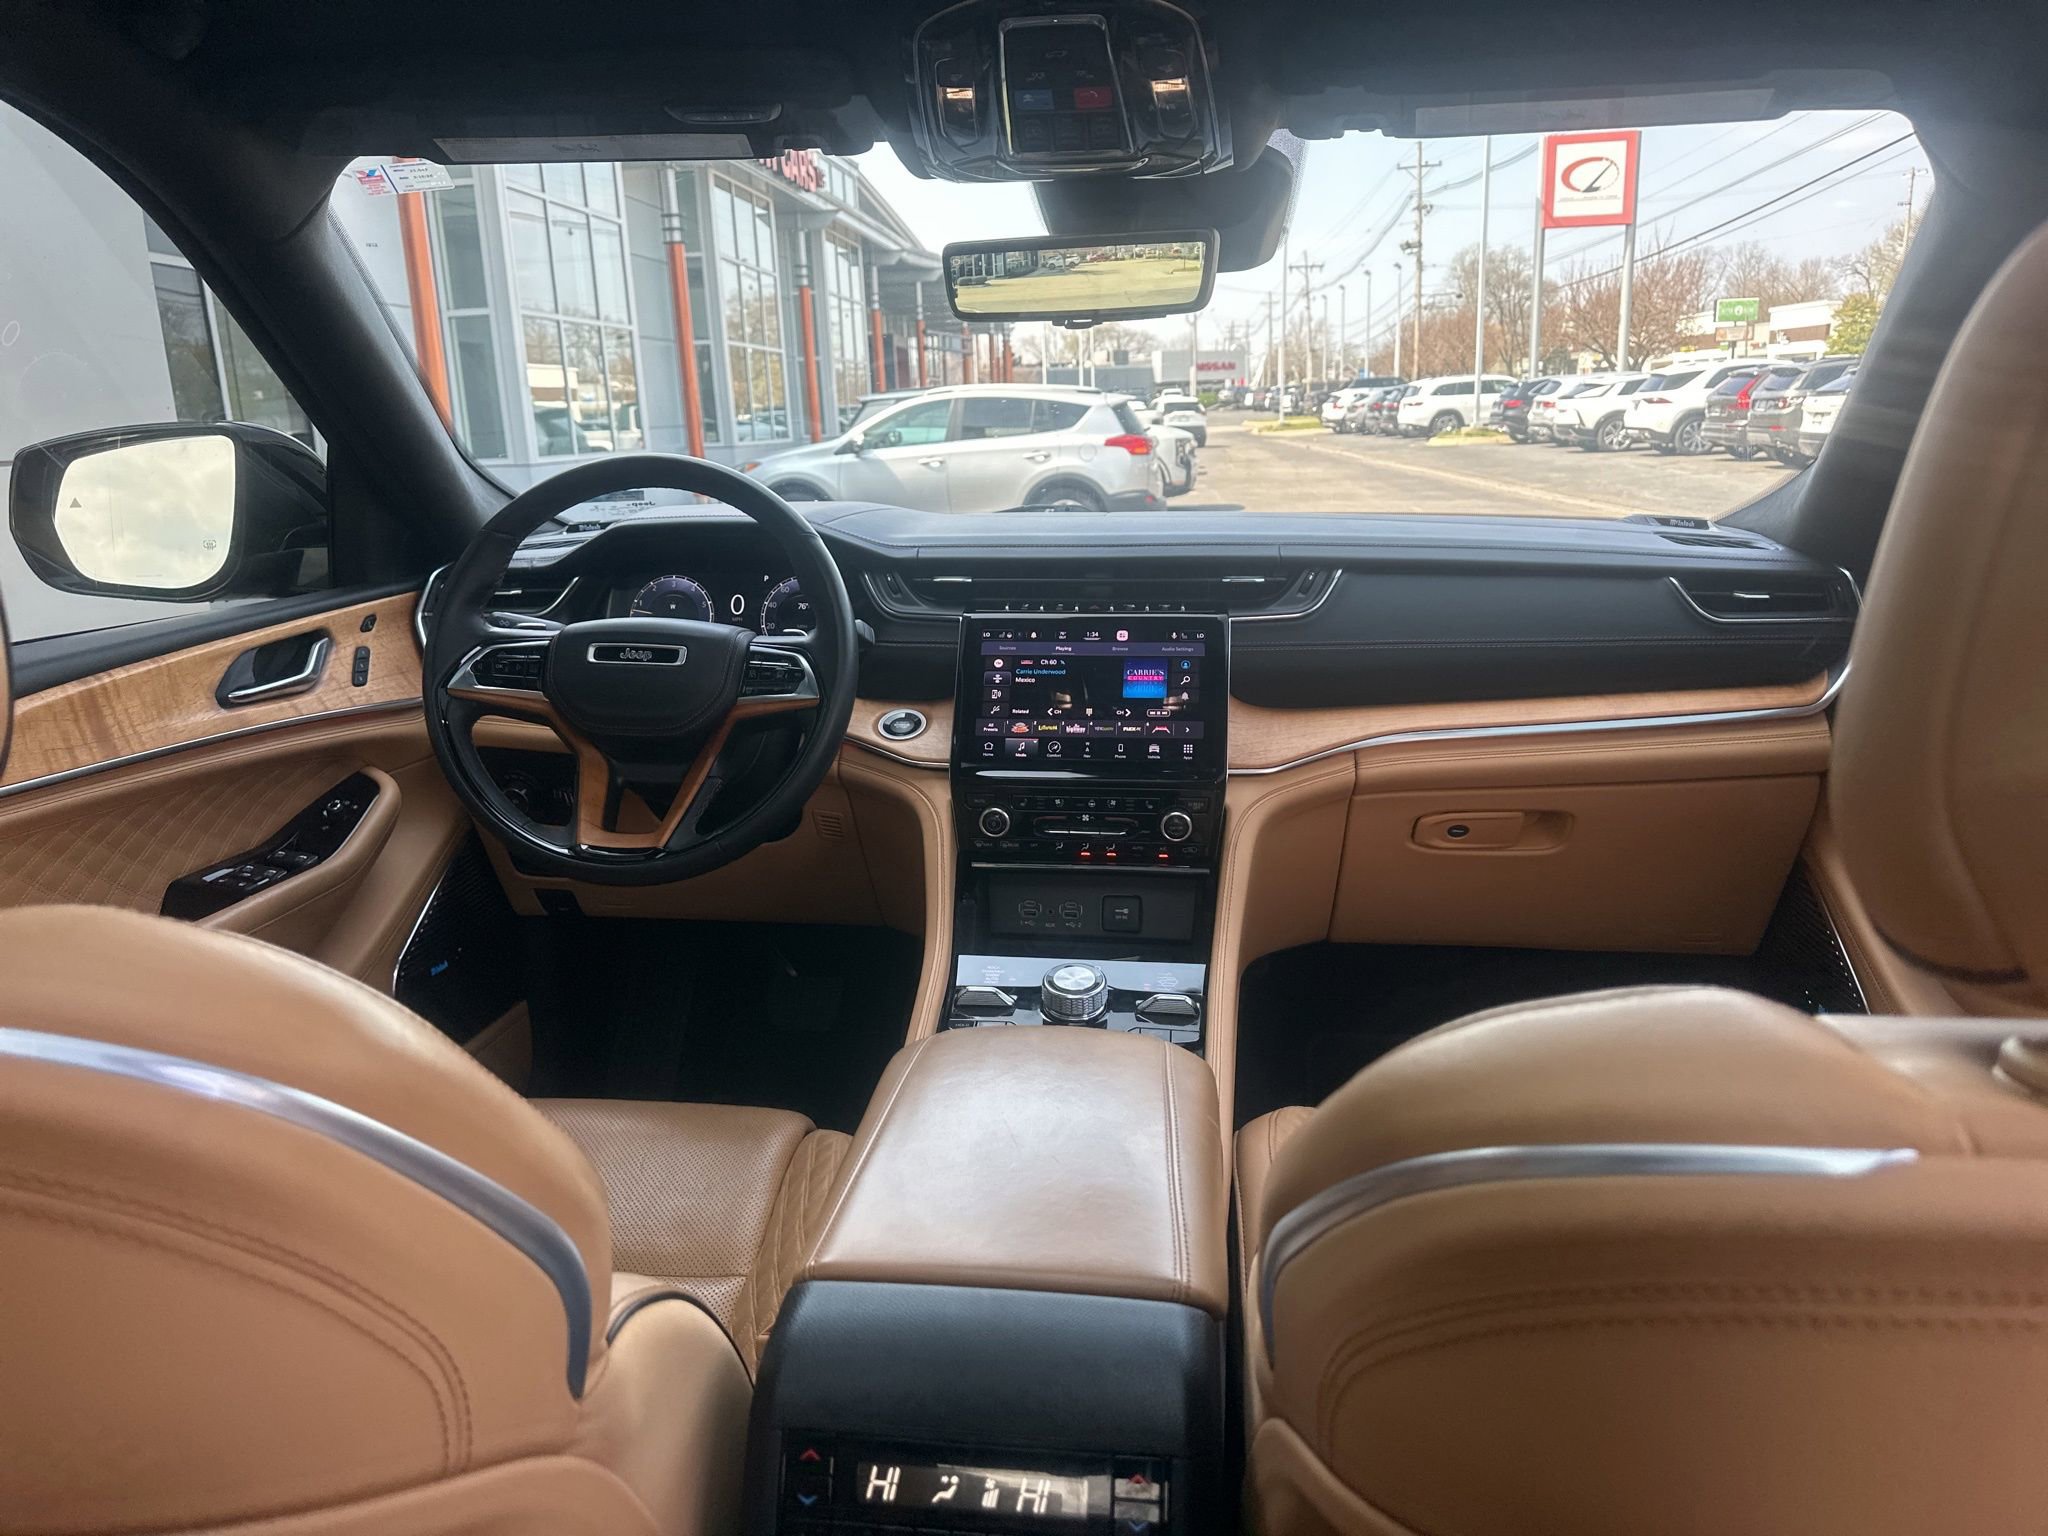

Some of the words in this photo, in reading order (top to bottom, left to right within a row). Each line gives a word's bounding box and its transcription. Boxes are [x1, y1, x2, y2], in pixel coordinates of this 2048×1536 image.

[1196, 362, 1236, 372] NISSAN
[730, 594, 745, 616] 0
[620, 648, 652, 661] Jeep
